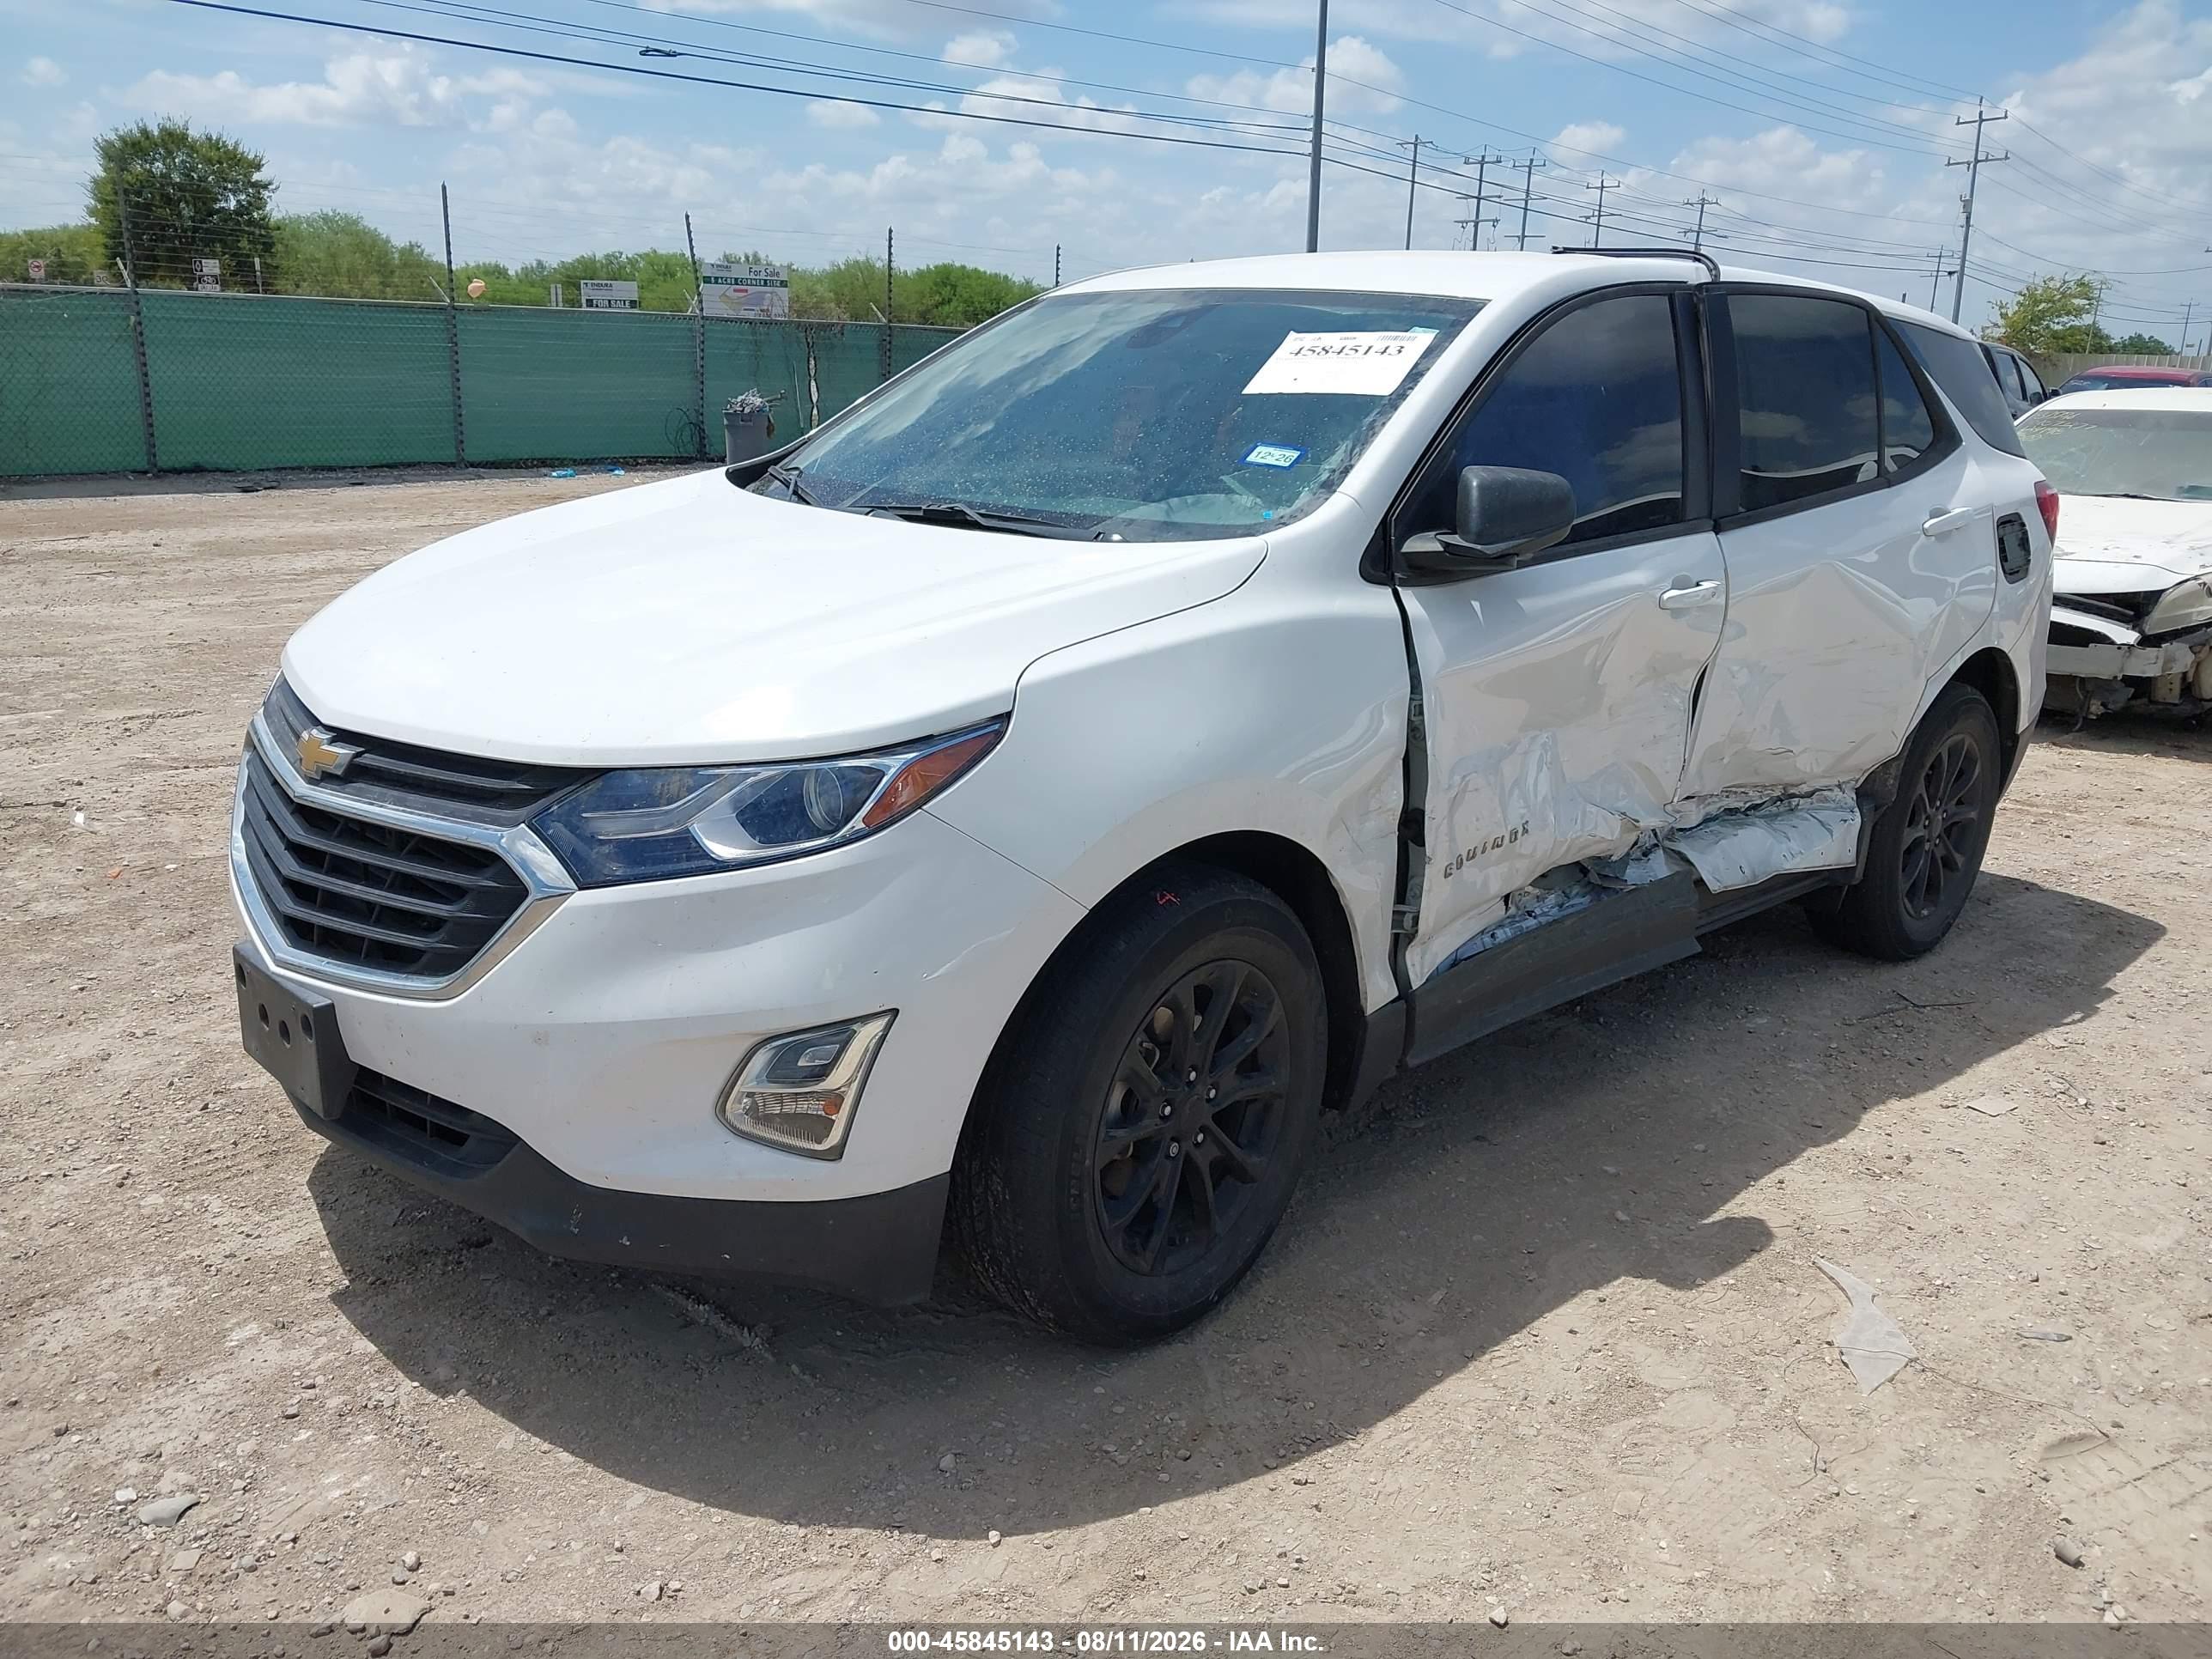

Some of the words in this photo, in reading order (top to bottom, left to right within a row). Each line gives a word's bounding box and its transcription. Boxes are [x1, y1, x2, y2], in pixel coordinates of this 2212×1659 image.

[749, 267, 762, 276] For
[764, 268, 781, 277] Sale
[611, 300, 630, 308] SALE
[1289, 345, 1405, 356] 45845143
[1443, 820, 1529, 879] EQUINOX
